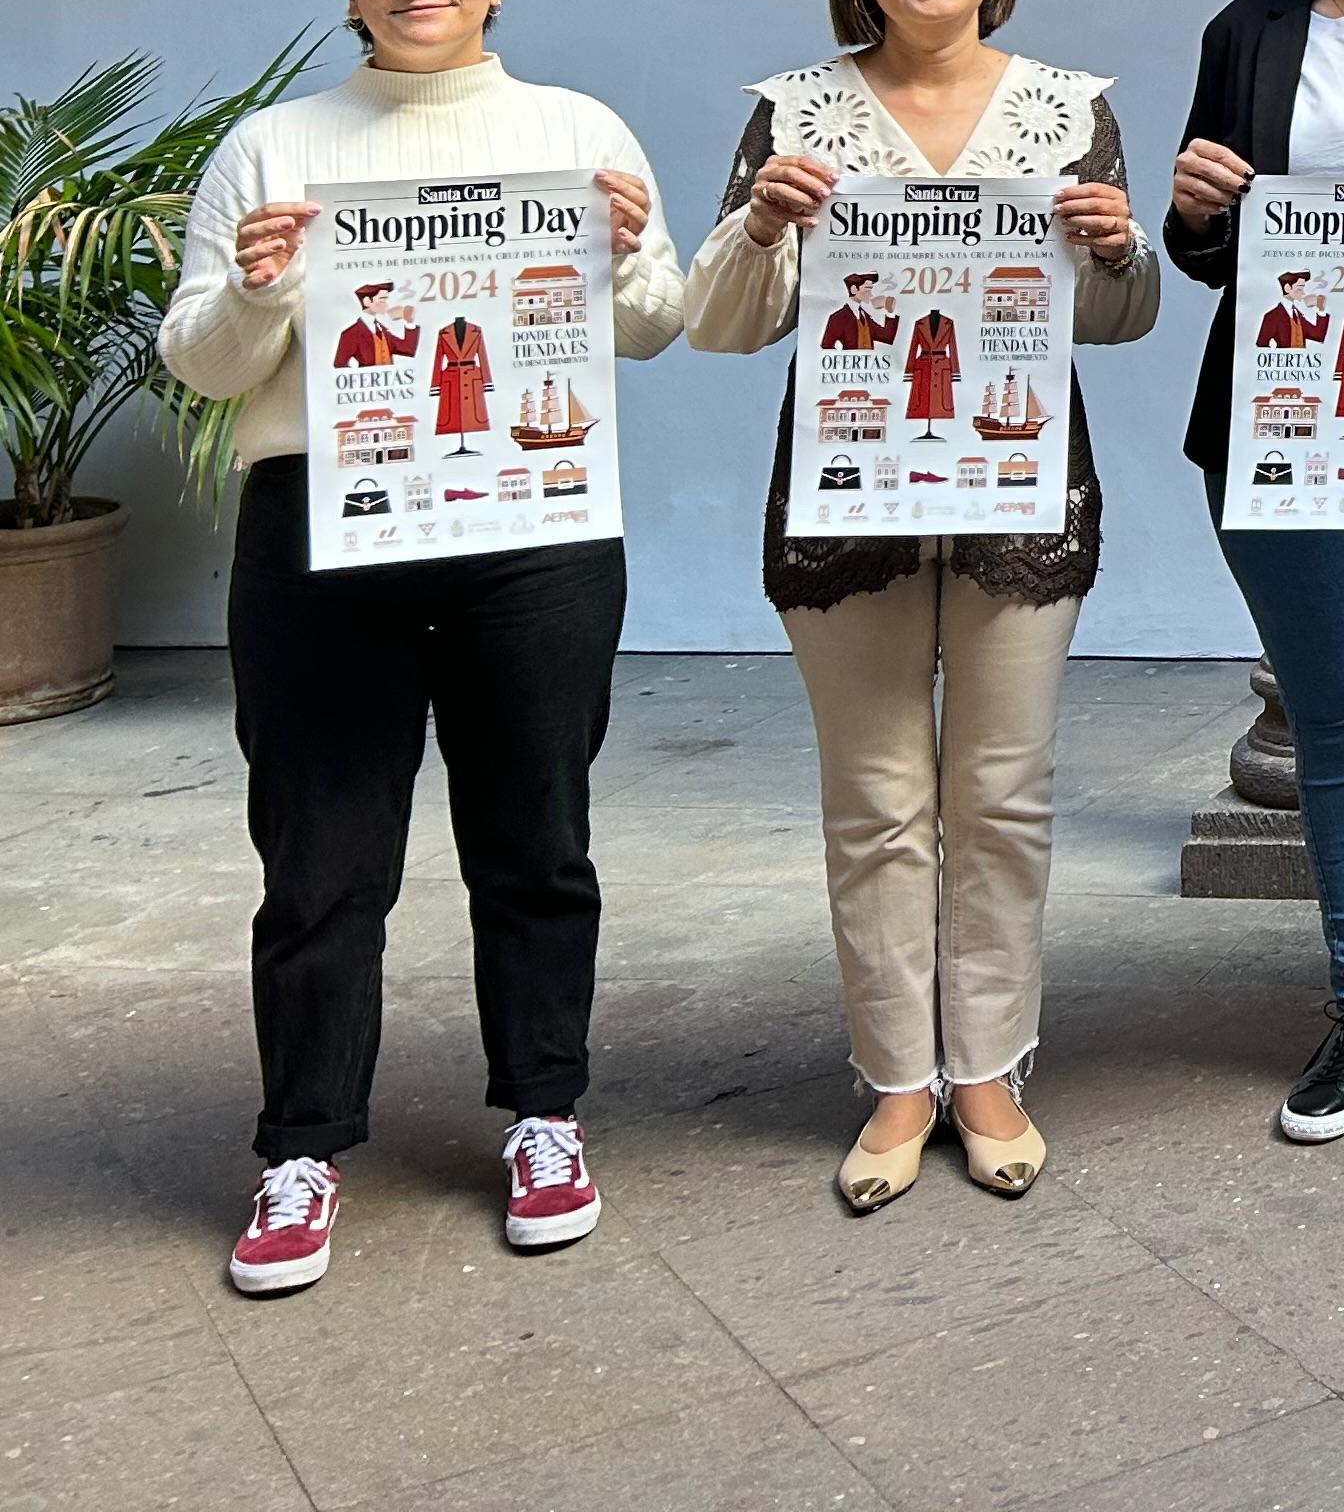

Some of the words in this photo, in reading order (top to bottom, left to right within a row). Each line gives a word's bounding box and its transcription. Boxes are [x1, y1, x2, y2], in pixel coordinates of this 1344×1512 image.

[419, 186, 461, 202] Santa
[462, 184, 497, 200] Cruz
[906, 185, 943, 200] Santa
[945, 186, 976, 200] Cruz
[334, 205, 506, 252] Shopping
[519, 199, 588, 243] Day
[830, 201, 983, 247] Shopping
[994, 202, 1057, 246] Day
[335, 261, 374, 271] JUEVES
[386, 259, 400, 267] DE
[459, 253, 492, 263] SANTA
[495, 252, 520, 261] CRUZ
[523, 251, 535, 259] DE
[538, 250, 552, 258] LA
[555, 248, 588, 257] PALMA
[418, 269, 499, 303] 2024
[899, 266, 972, 295] 2024
[511, 329, 552, 343] DONDE
[554, 327, 588, 340] CADA
[979, 327, 1016, 338] DONDE
[1018, 326, 1049, 338] CADA
[513, 342, 567, 359] TIENDA
[570, 340, 589, 355] ES
[980, 339, 1029, 353] TIENDA
[1032, 339, 1049, 353] ES
[821, 354, 891, 371] OFERTAS
[1256, 352, 1322, 368] OFERTAS
[335, 368, 415, 391] OFERTAS
[821, 372, 889, 385] EXCLUSIVAS
[1256, 369, 1320, 382] EXCLUSIVAS
[336, 388, 414, 406] EXCLUSIVAS
